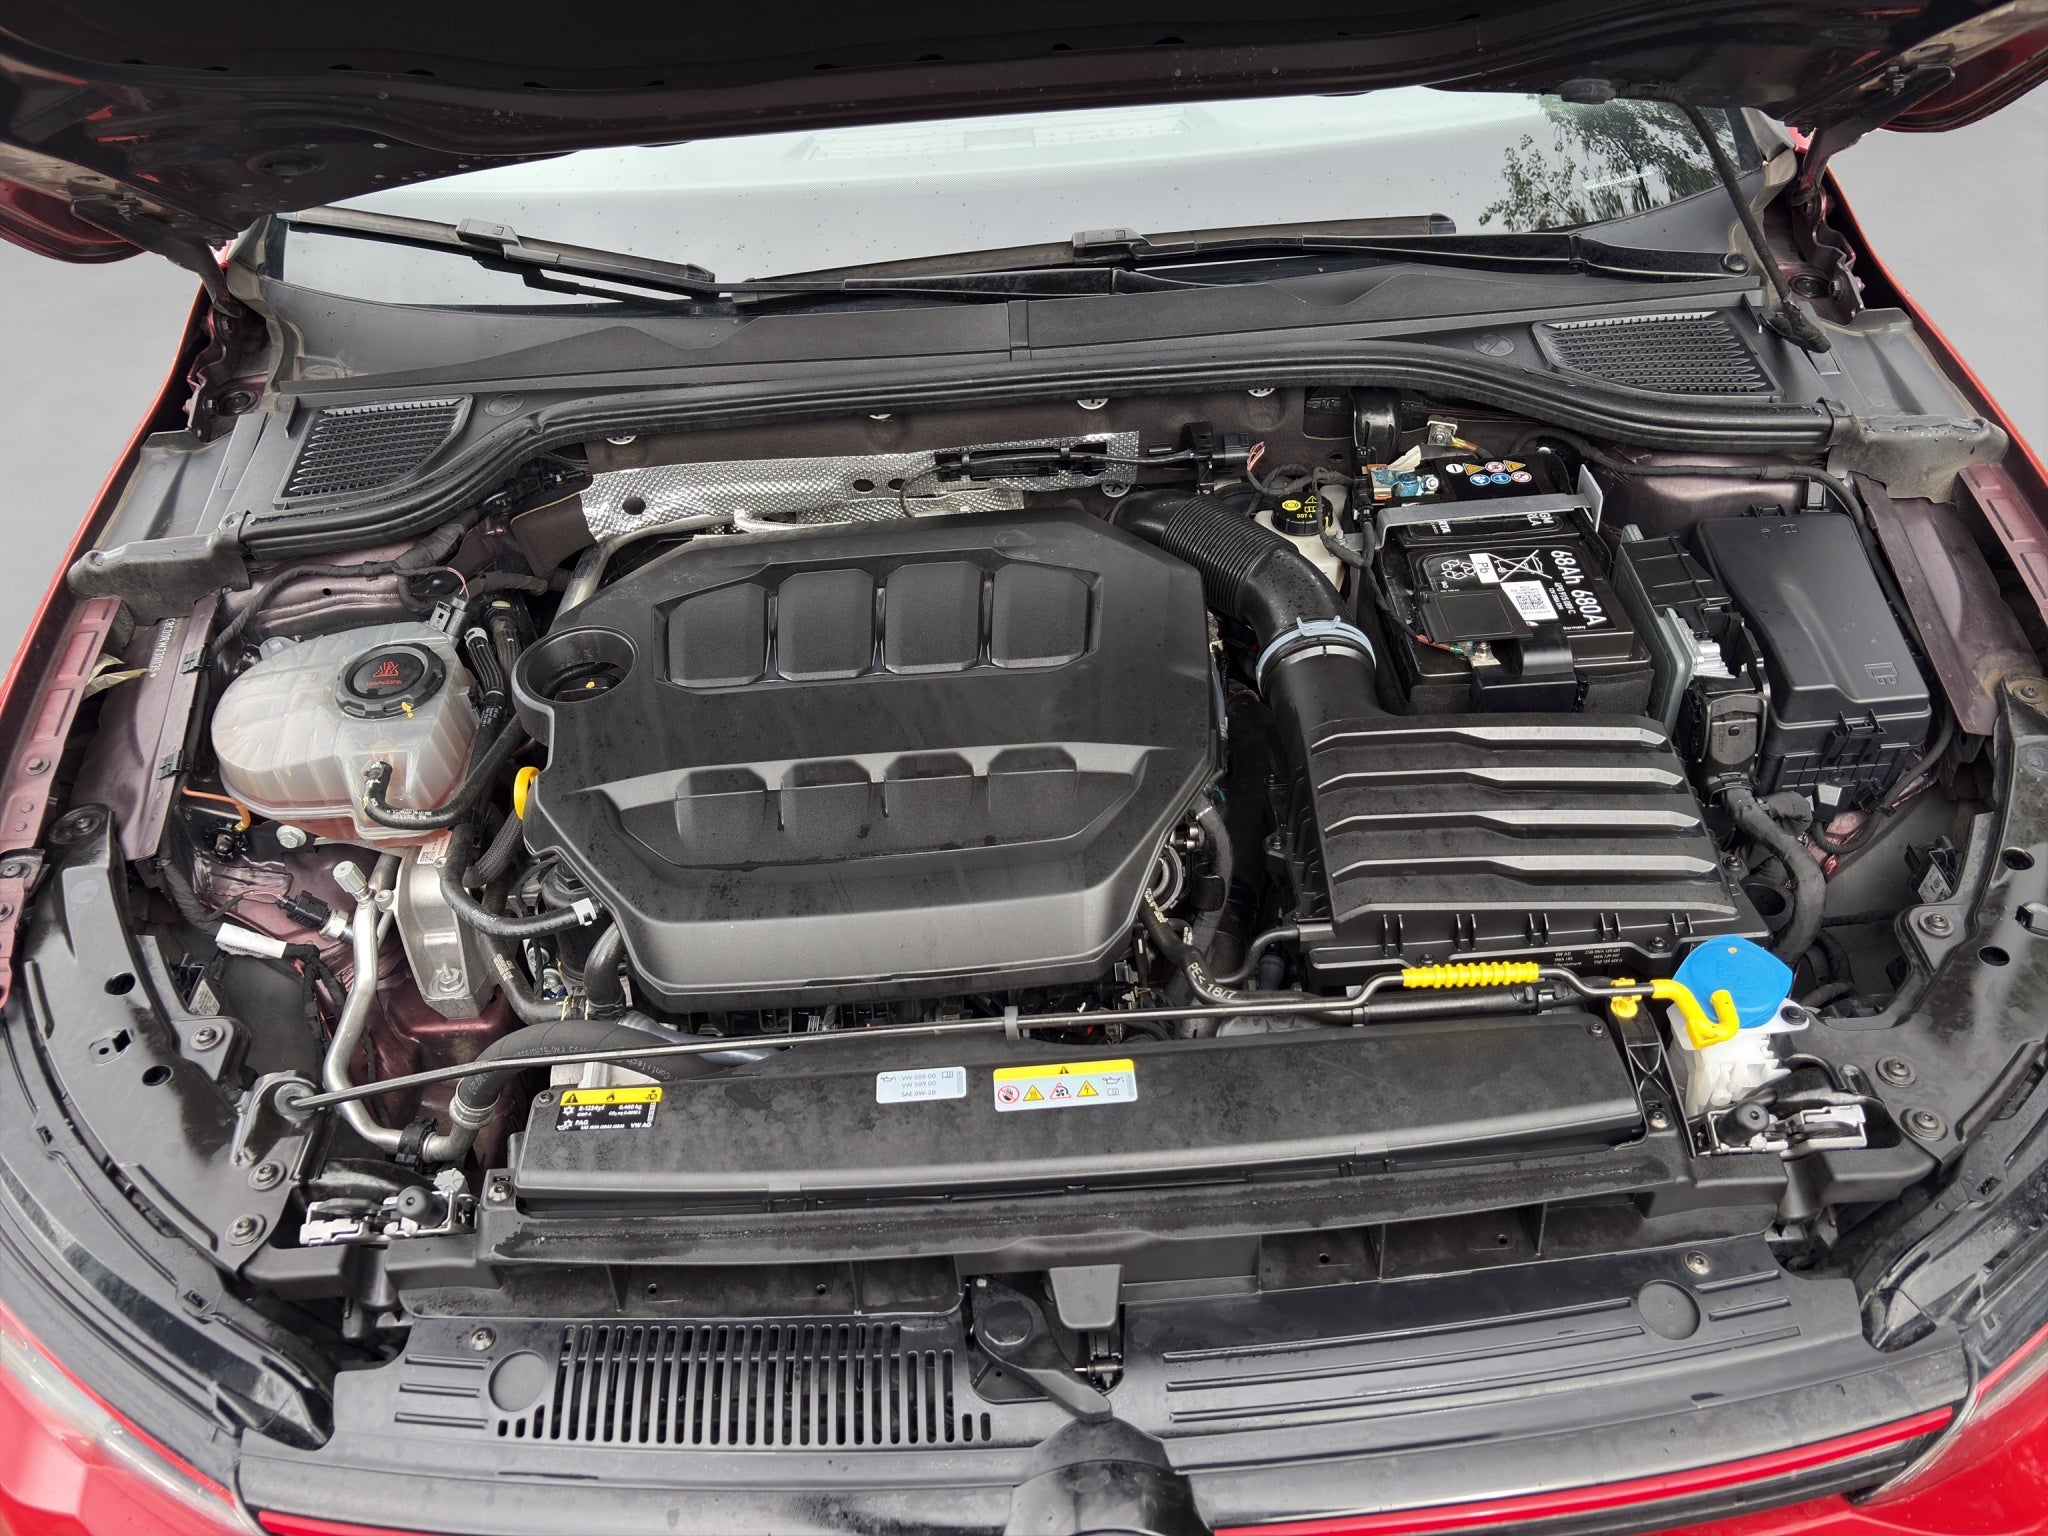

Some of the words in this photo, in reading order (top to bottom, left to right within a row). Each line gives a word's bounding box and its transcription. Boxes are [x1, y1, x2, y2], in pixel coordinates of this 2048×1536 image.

[1539, 512, 1554, 523] GM
[1477, 562, 1490, 574] Pb
[1550, 550, 1585, 585] 68Ah
[1570, 589, 1608, 626] 680A
[578, 1104, 605, 1112] R-1234yf
